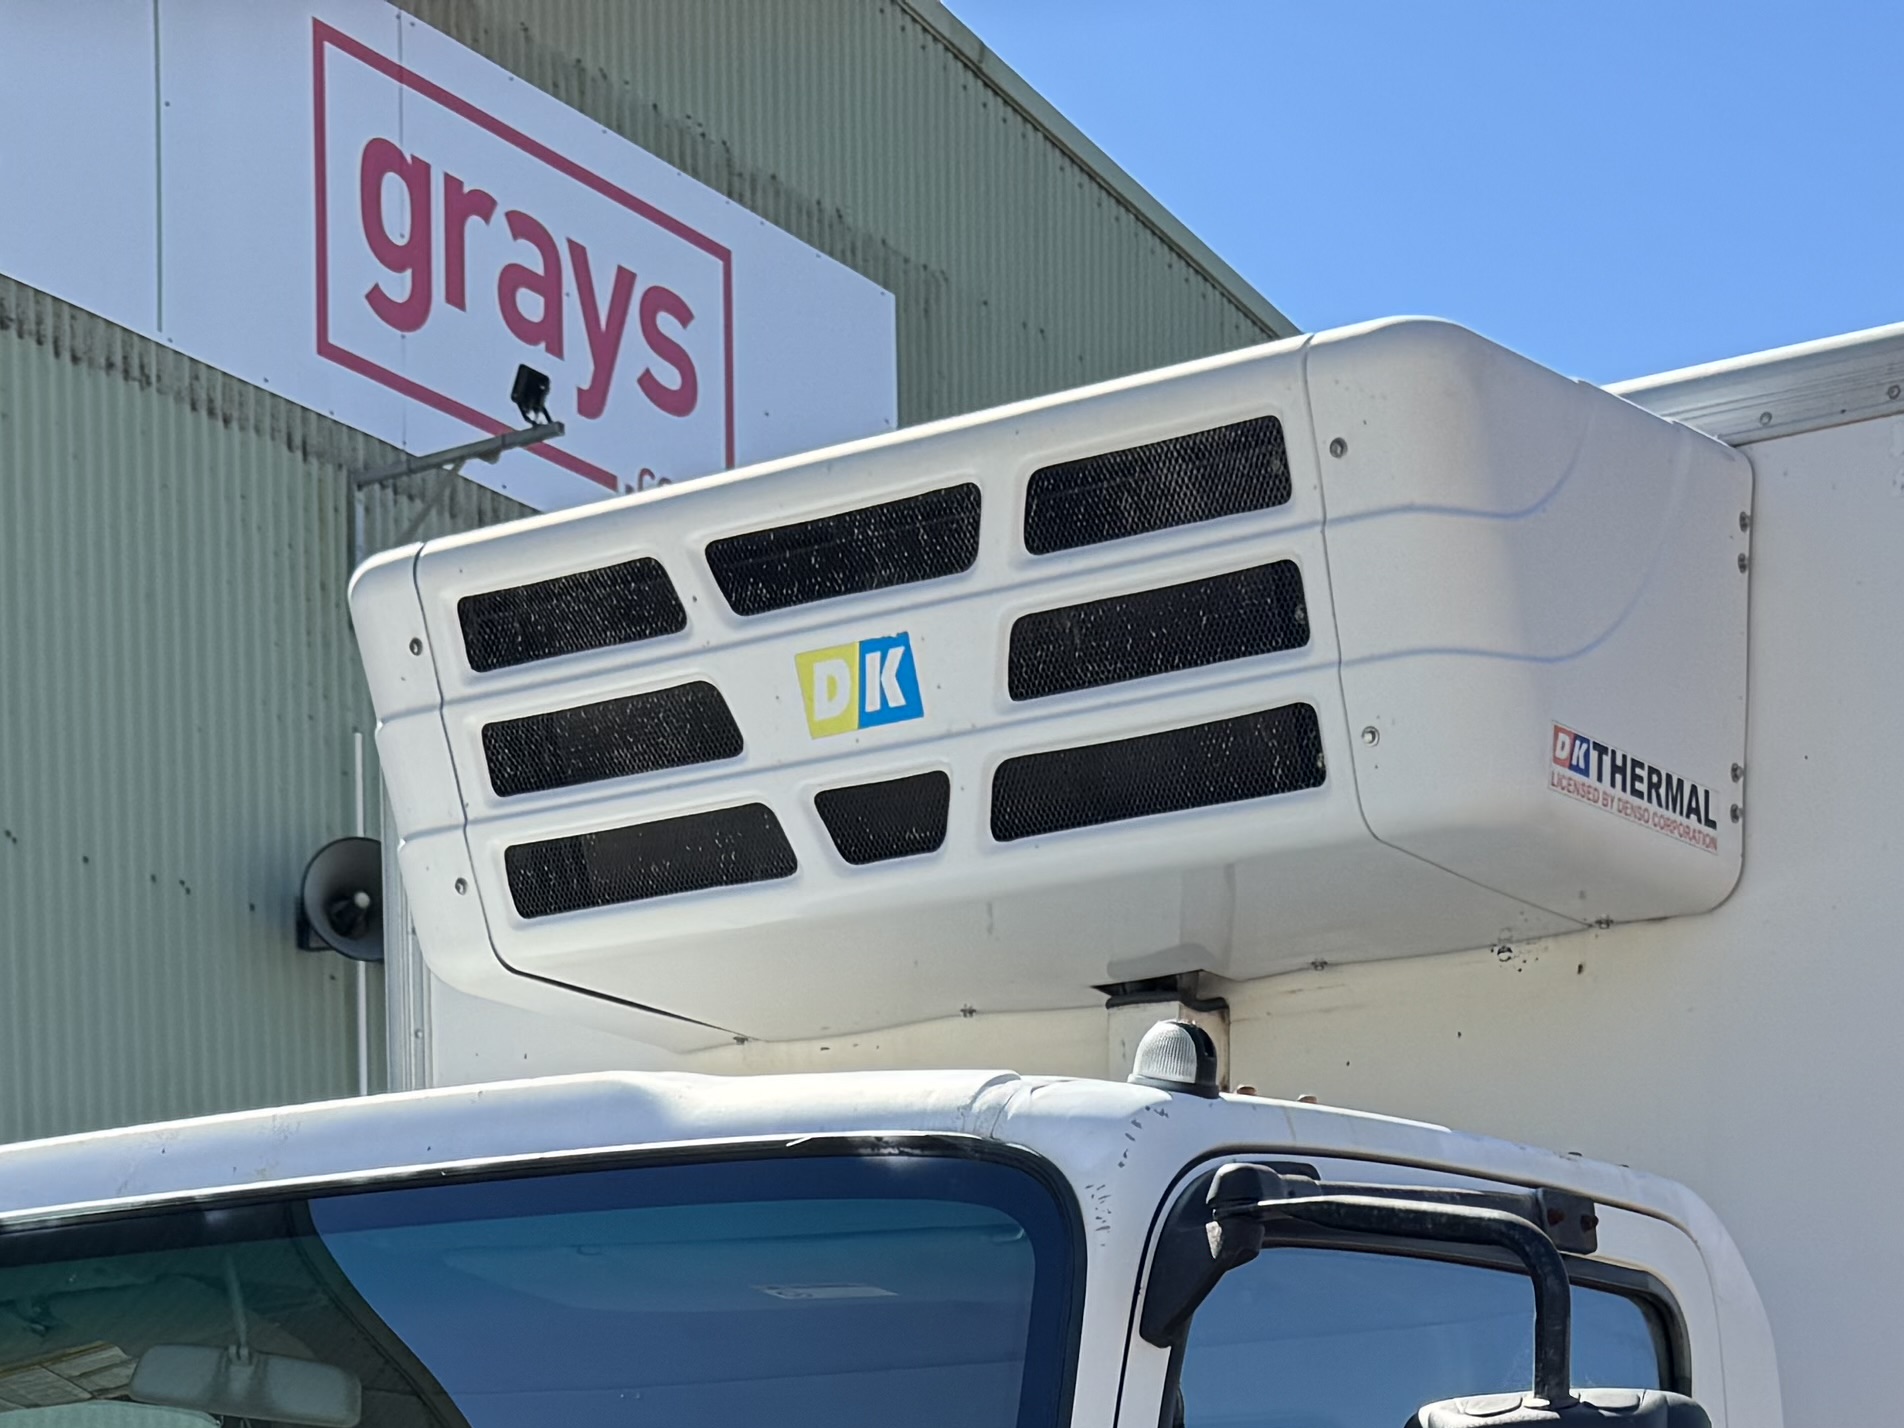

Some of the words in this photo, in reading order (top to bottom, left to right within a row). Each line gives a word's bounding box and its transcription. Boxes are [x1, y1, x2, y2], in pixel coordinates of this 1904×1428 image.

[360, 137, 698, 420] grays
[812, 646, 907, 722] DK
[1550, 771, 1600, 804] LICENSED
[1601, 790, 1614, 810] BY
[1617, 797, 1650, 824] DENSO
[1652, 811, 1718, 851] CORPORATION
[1592, 741, 1717, 830] THERMAL
